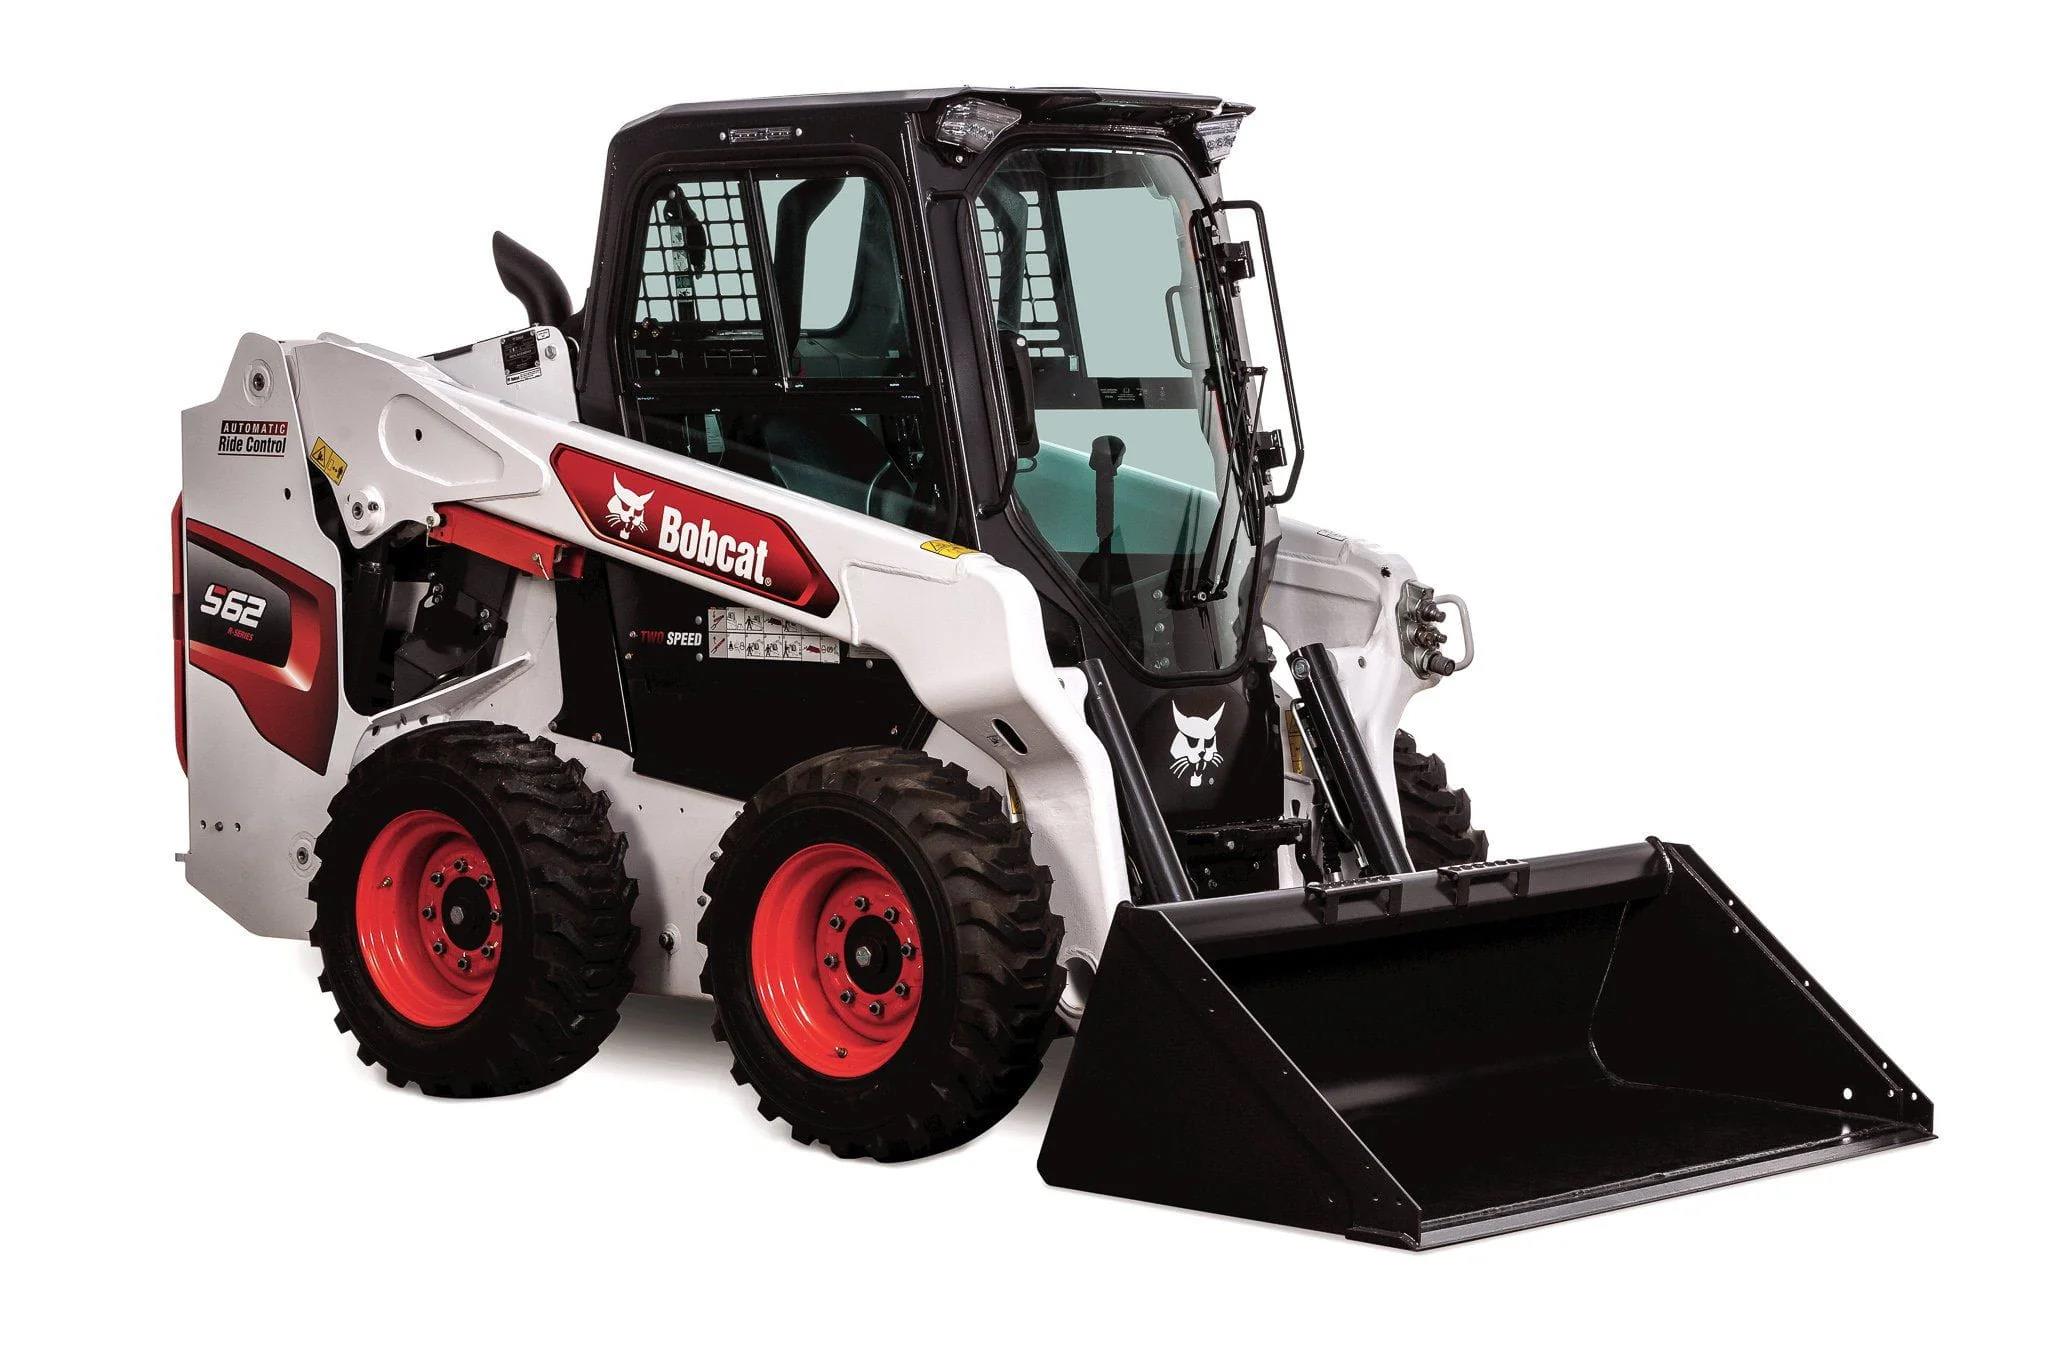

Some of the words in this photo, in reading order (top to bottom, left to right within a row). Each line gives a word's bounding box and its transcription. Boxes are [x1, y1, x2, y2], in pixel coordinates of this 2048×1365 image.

[223, 422, 286, 434] AUTOMATIC
[218, 436, 243, 452] Ride
[246, 437, 286, 453] Control
[658, 505, 768, 586] Bobcat
[200, 584, 267, 629] S62
[227, 626, 254, 642] R-SERIES
[640, 630, 665, 644] TWO
[666, 631, 702, 646] SPEED
